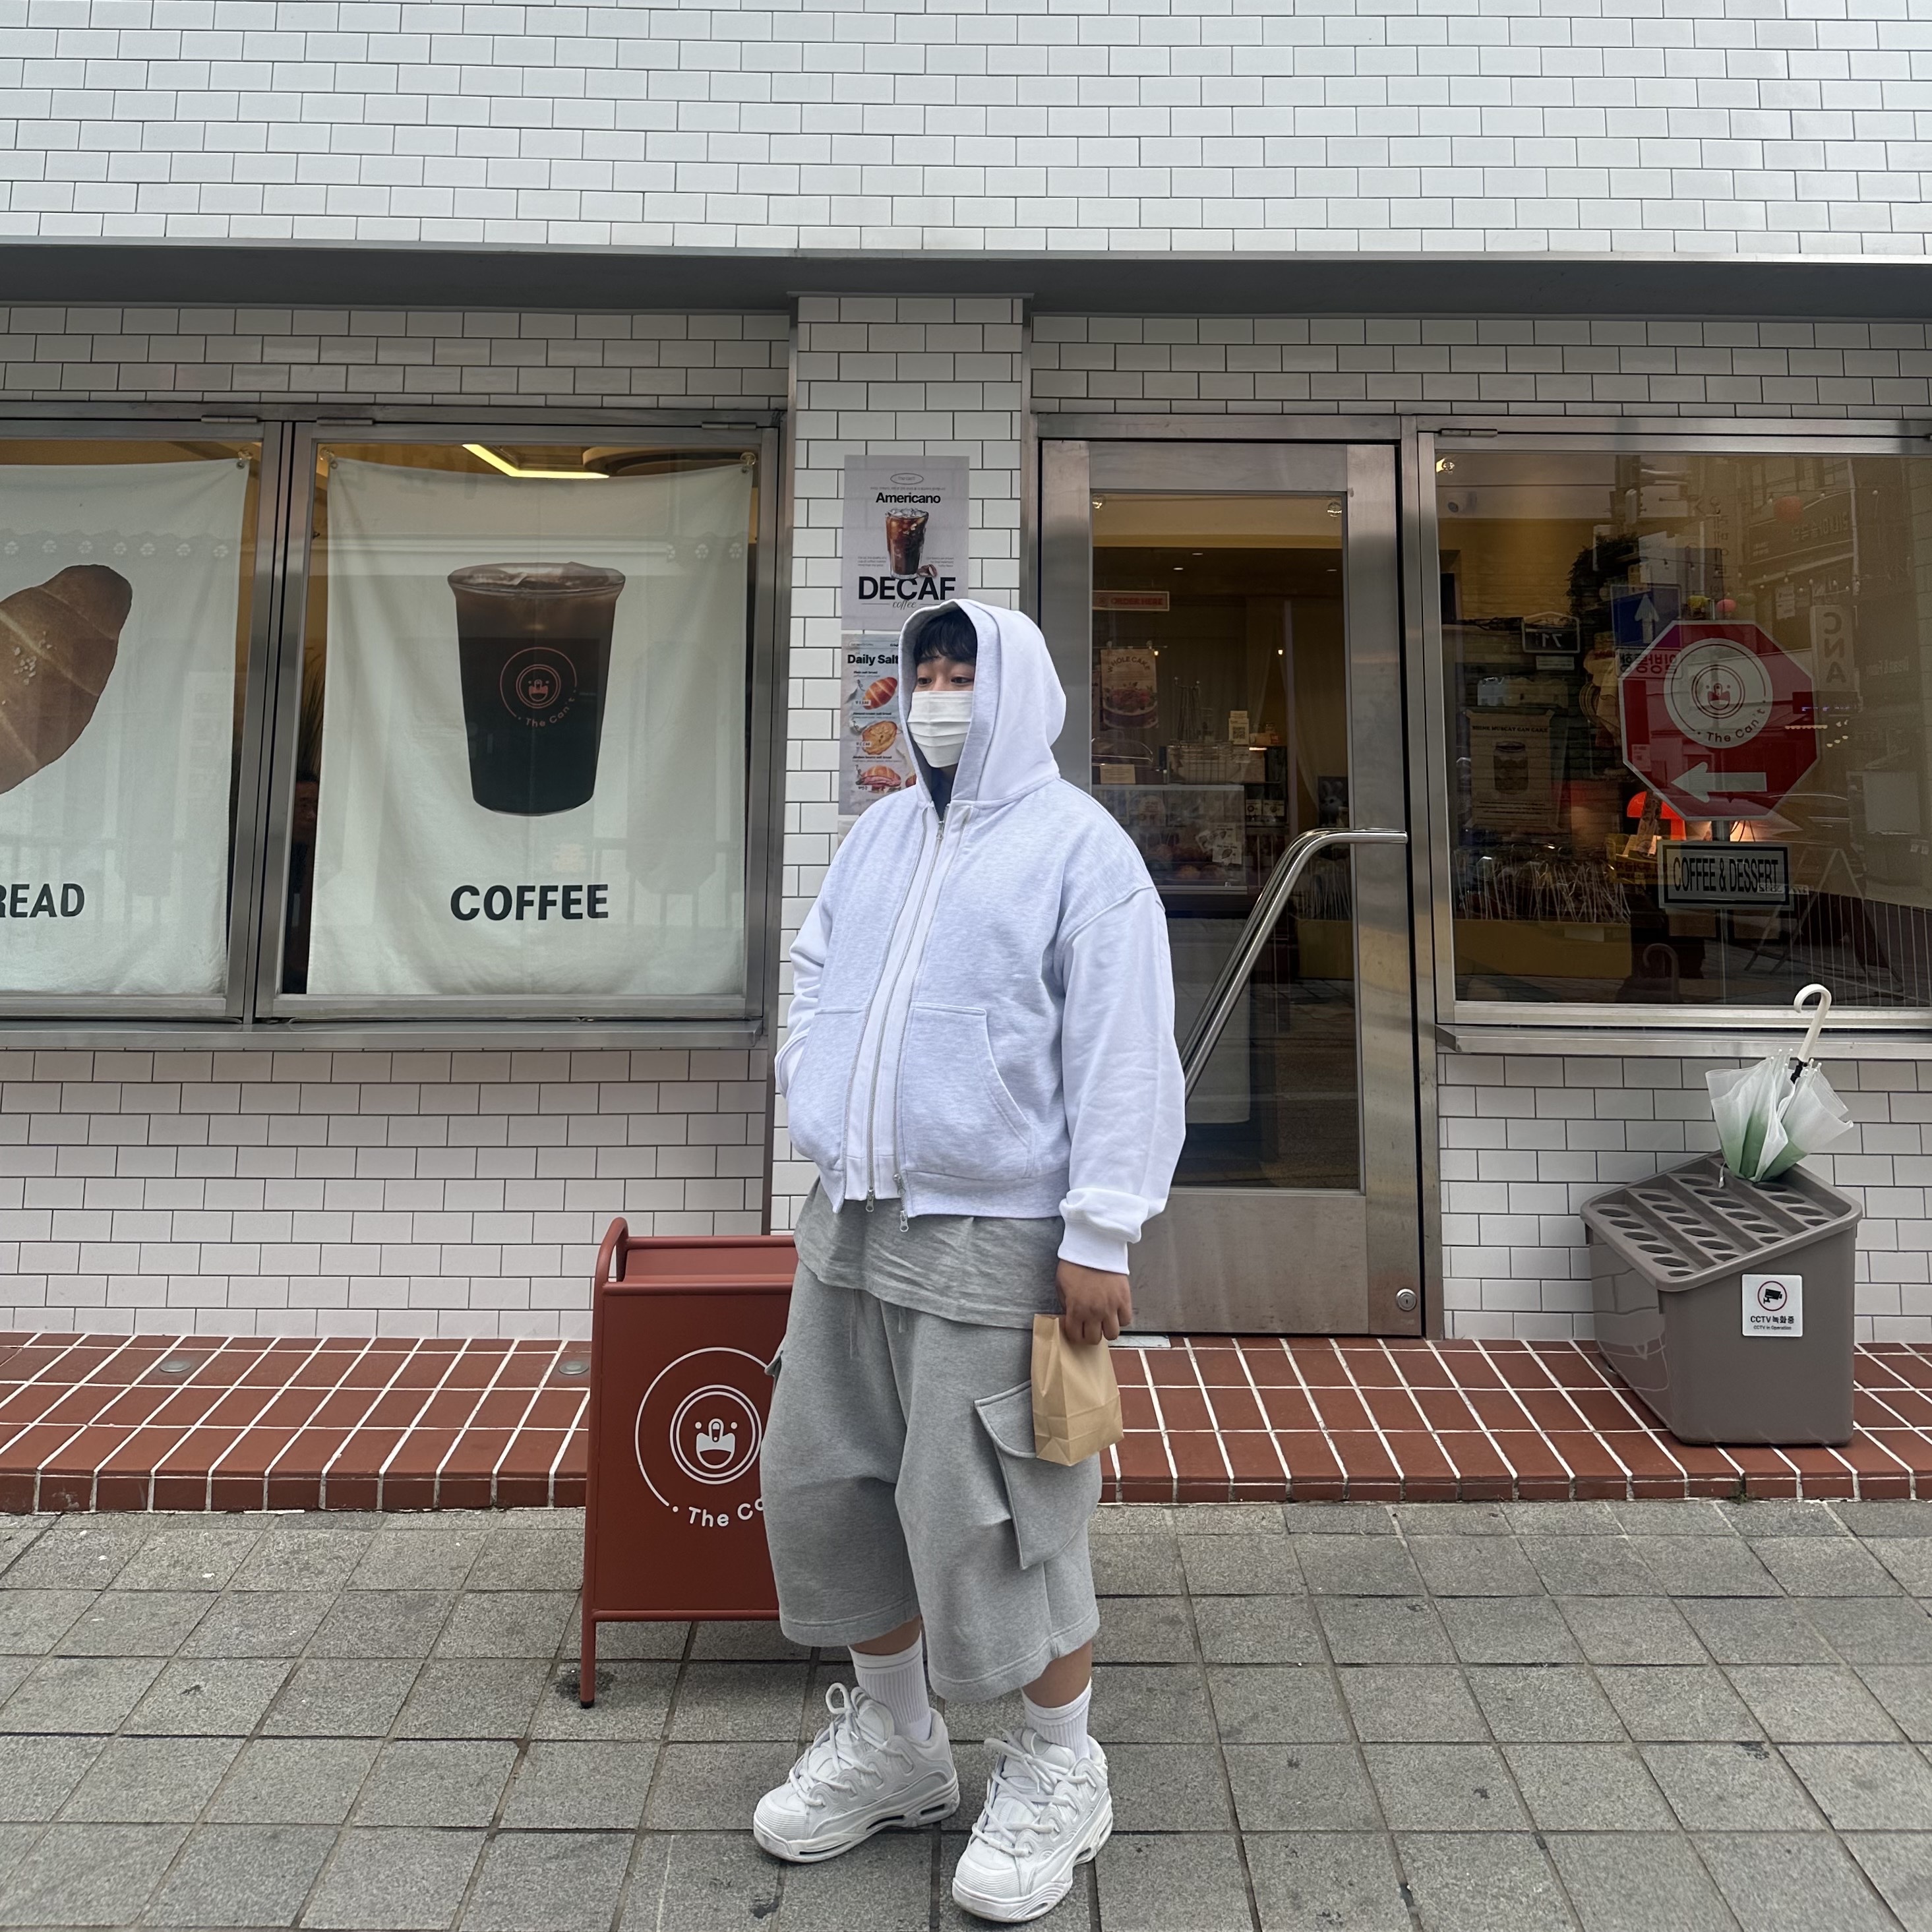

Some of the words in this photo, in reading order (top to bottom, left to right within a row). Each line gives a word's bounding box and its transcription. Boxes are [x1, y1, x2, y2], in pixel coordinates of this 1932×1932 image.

[876, 492, 941, 504] Americano
[859, 576, 956, 601] DECAF
[892, 599, 917, 610] coffee
[847, 653, 876, 666] Daily
[878, 654, 899, 664] Salt
[1108, 656, 1131, 673] WHOLE
[1132, 656, 1151, 671] CAKE
[526, 717, 546, 728] The
[1706, 731, 1731, 742] The
[1736, 708, 1766, 739] Can't
[1673, 857, 1716, 892] COFFEE
[1719, 858, 1727, 892] &
[1729, 858, 1778, 893] DESSERT
[450, 884, 609, 921] COFFEE
[688, 1506, 729, 1528] The
